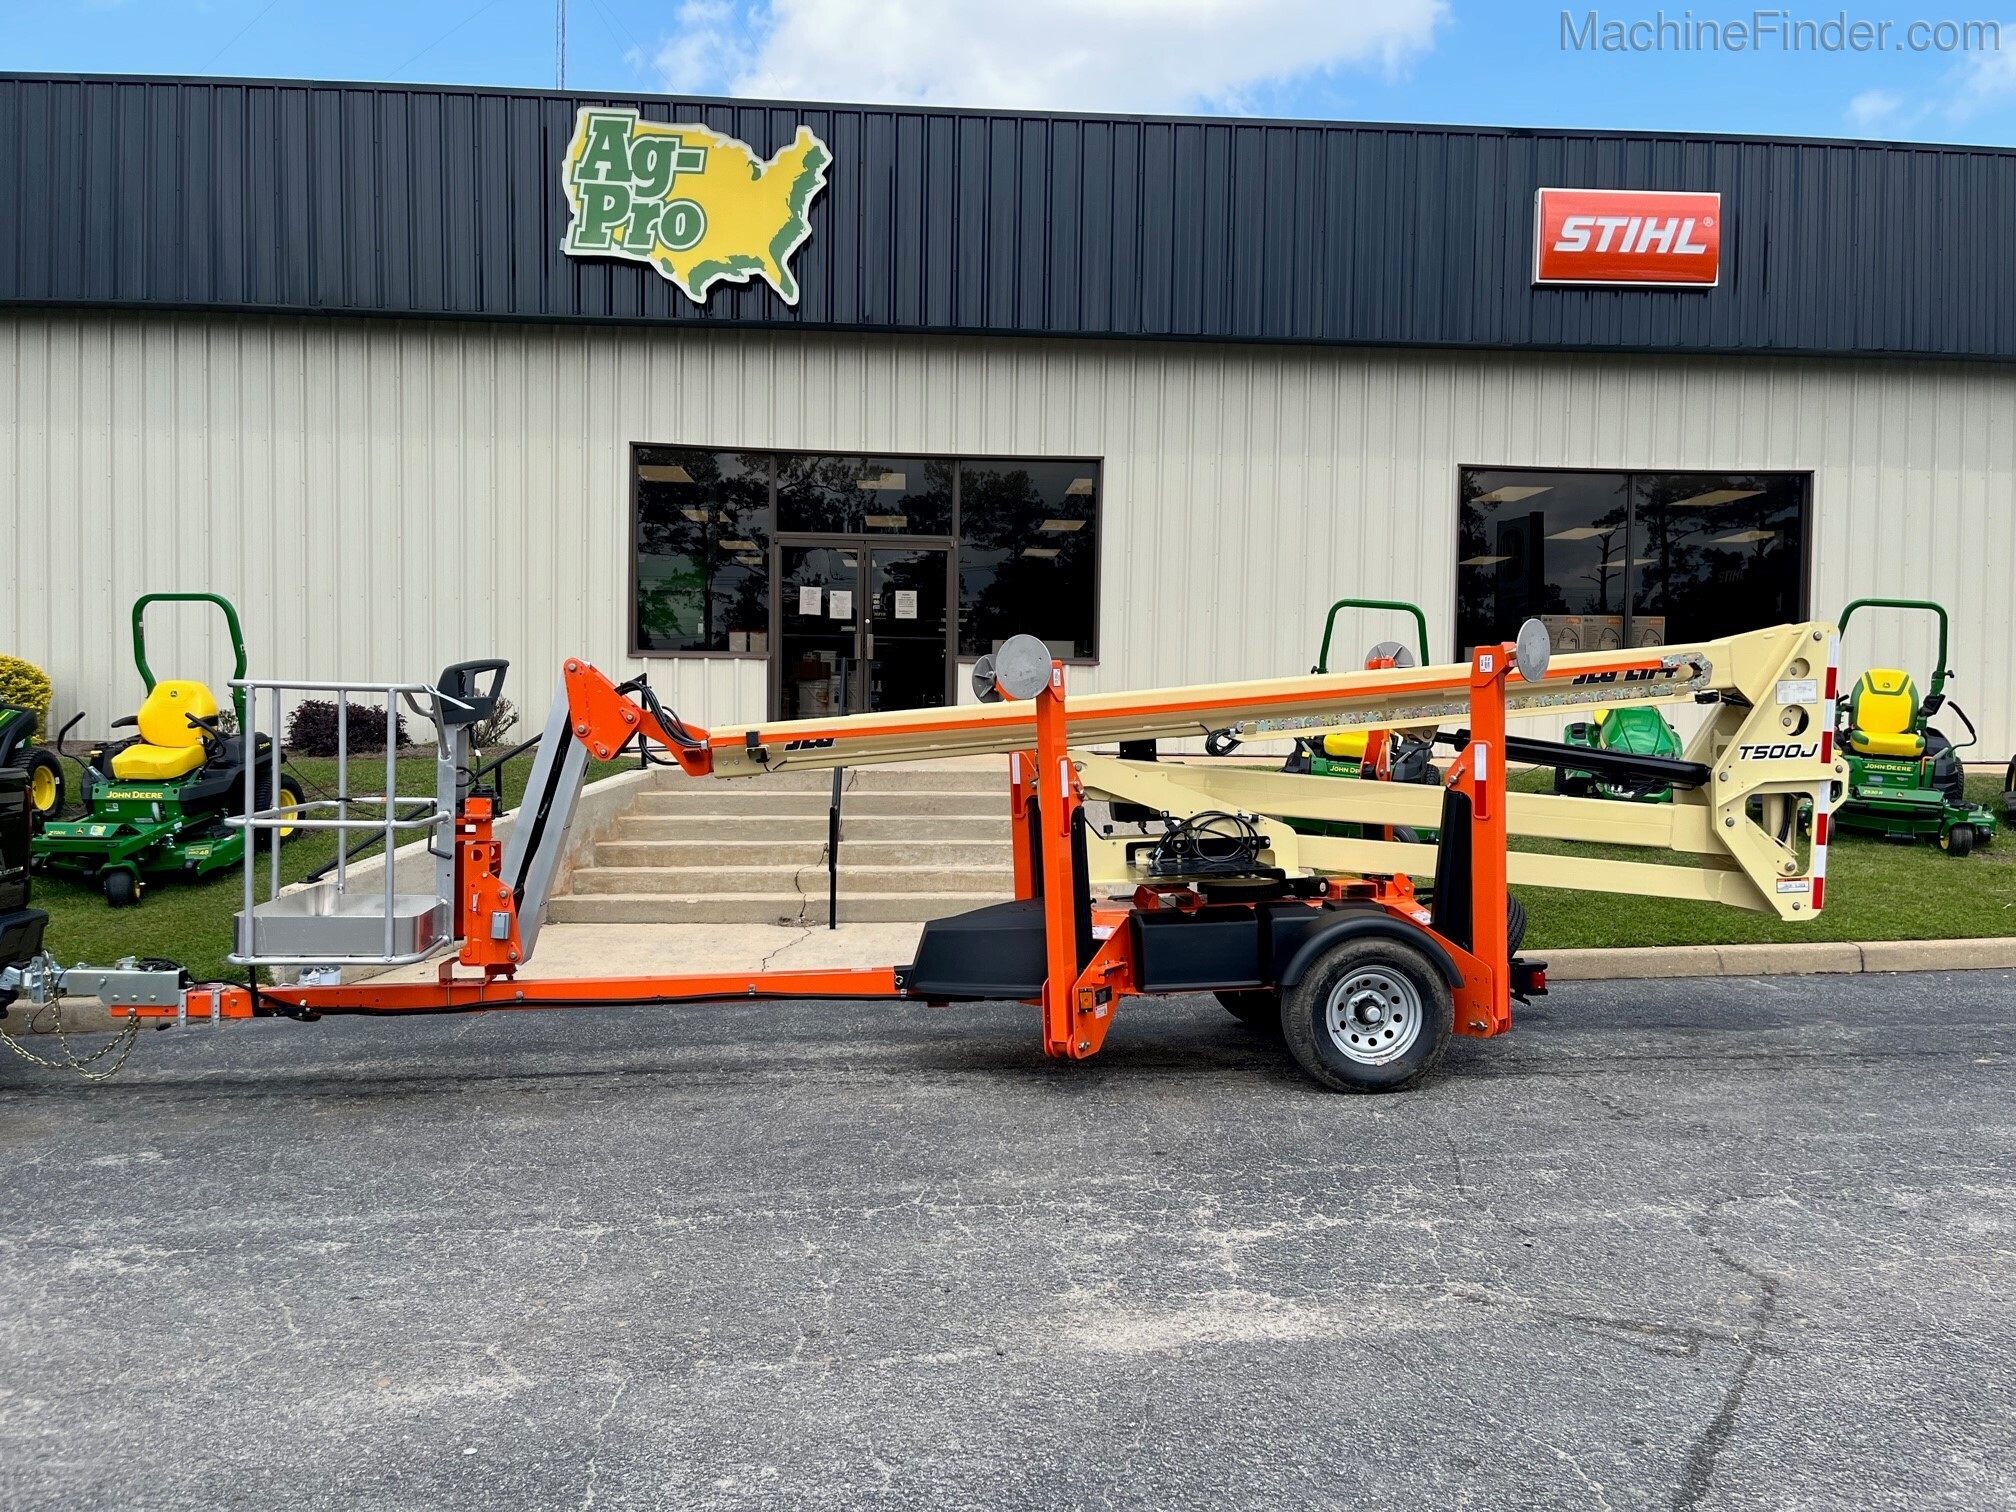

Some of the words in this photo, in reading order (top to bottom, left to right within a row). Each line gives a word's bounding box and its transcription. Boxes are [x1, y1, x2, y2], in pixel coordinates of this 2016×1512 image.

[571, 112, 708, 200] Ag-
[571, 182, 708, 252] Pro
[1553, 215, 1707, 255] STIHL
[1738, 743, 1819, 760] T500J
[1330, 765, 1349, 773] JOHN
[1886, 764, 1912, 772] DEERE
[106, 790, 132, 799] JOHN
[132, 791, 164, 799] DEERE
